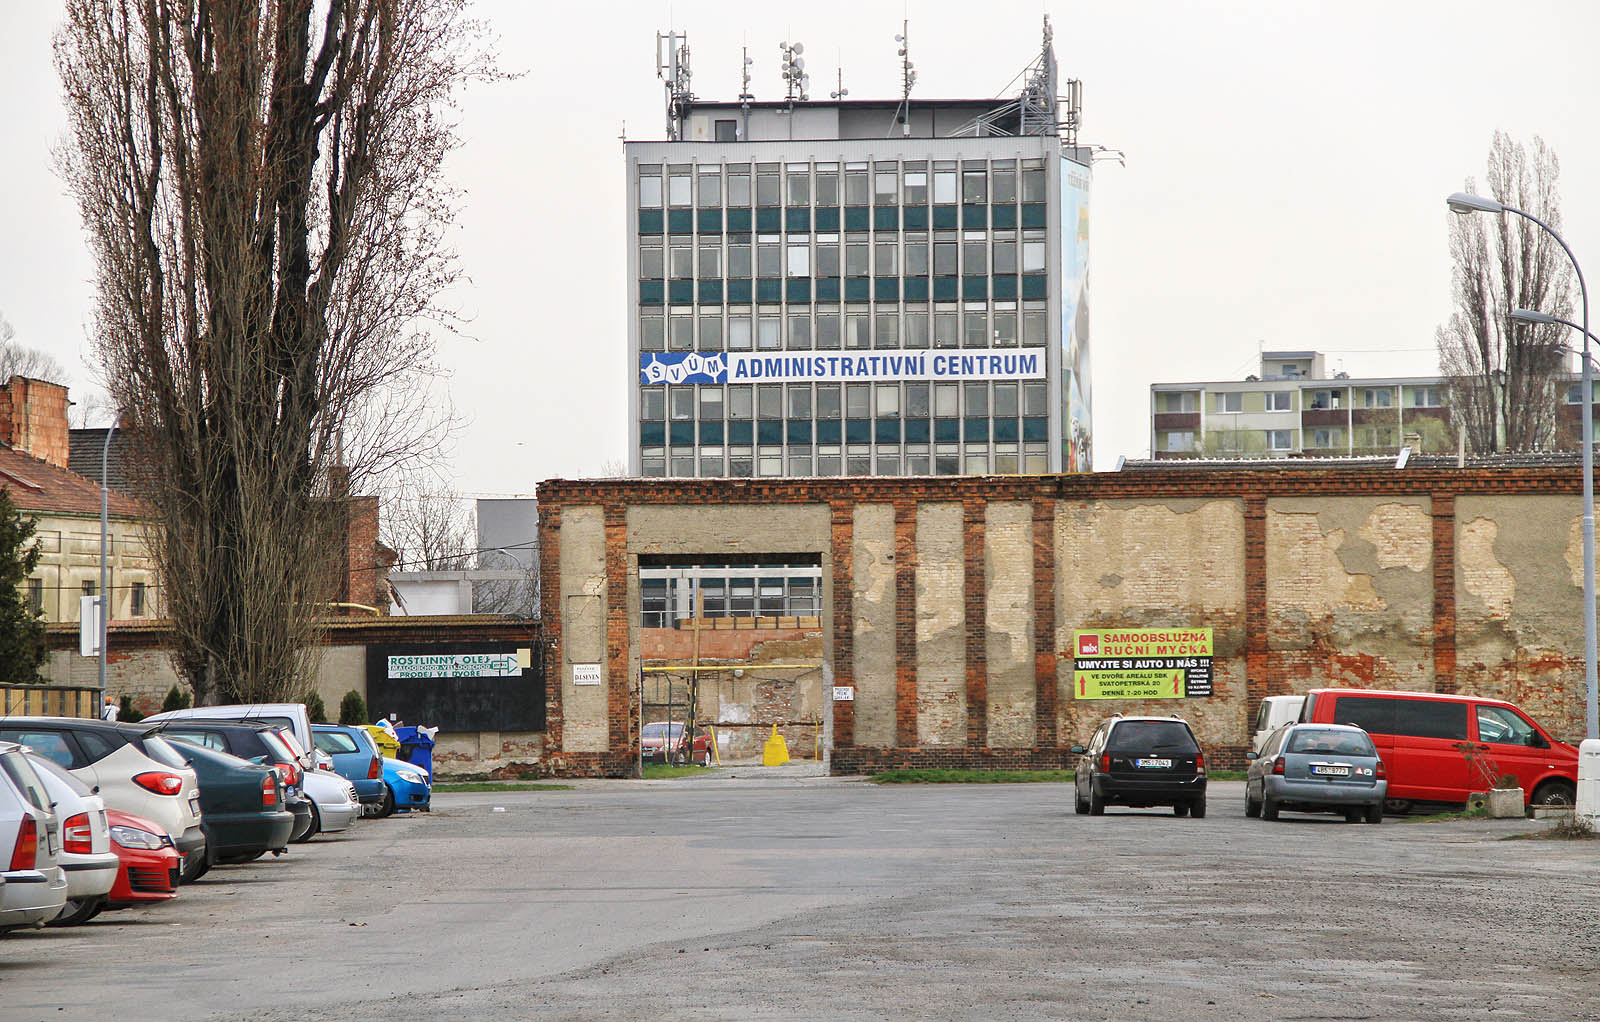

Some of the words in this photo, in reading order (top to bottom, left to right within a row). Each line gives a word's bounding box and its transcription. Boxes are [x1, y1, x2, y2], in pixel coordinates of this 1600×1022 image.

[652, 356, 719, 381] SVÚM
[735, 351, 925, 379] ADMINISTRATIVNÍ
[933, 354, 1038, 376] CENTRUM
[1104, 631, 1207, 643] SAMOOBSLUŽNÁ
[1104, 644, 1150, 656] RUČNÍ
[1157, 643, 1209, 655] MYČKA
[390, 656, 456, 665] ROSTLINNÝ
[462, 655, 490, 664] OLEJ
[1078, 660, 1121, 669] UMYJTE
[1122, 660, 1133, 669] SI
[1135, 659, 1164, 668] AUTO
[1166, 659, 1174, 668] U
[1176, 657, 1197, 668] NÁS
